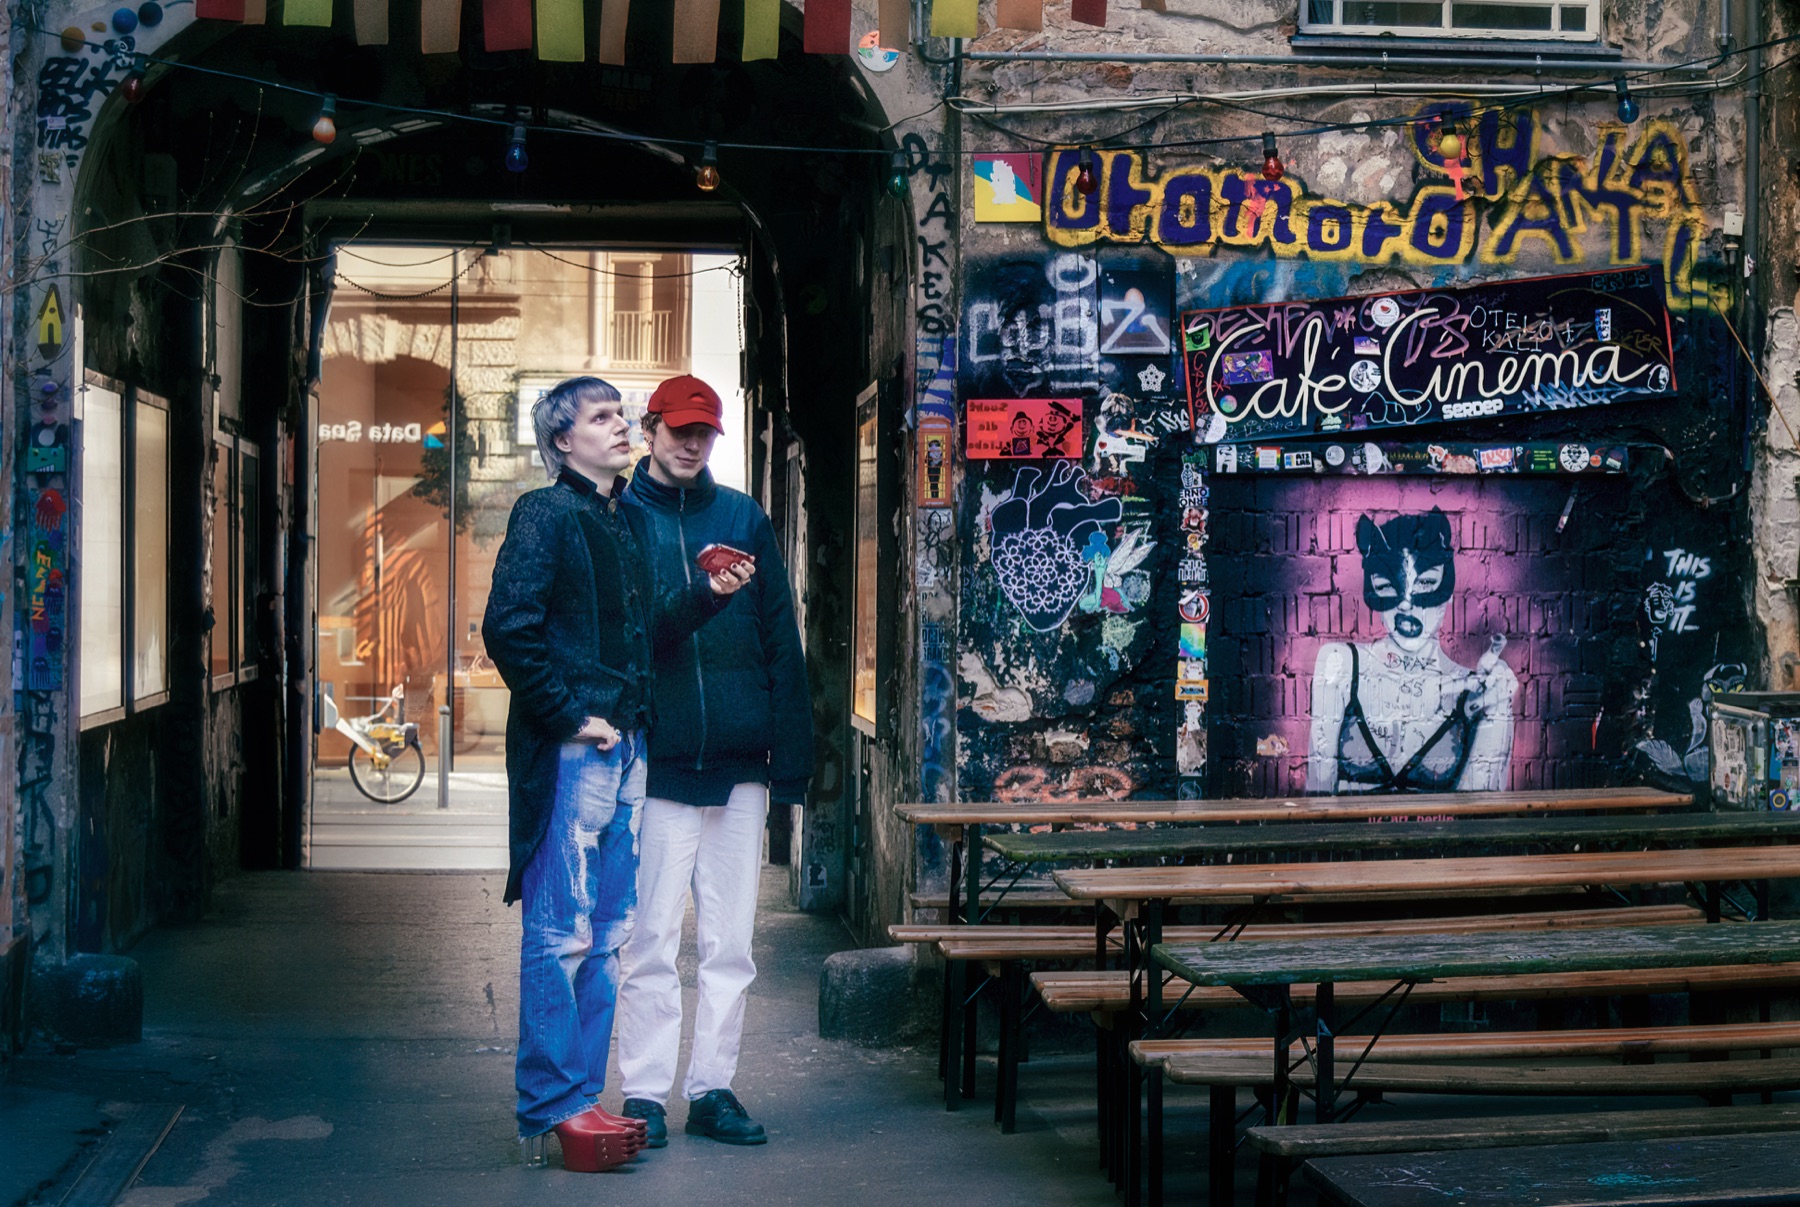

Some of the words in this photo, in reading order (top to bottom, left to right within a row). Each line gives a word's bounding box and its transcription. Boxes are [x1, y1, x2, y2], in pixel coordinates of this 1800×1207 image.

[1207, 317, 1352, 426] Café
[1384, 307, 1656, 407] Cinema
[1663, 548, 1711, 579] THIS
[1674, 580, 1697, 603] IS
